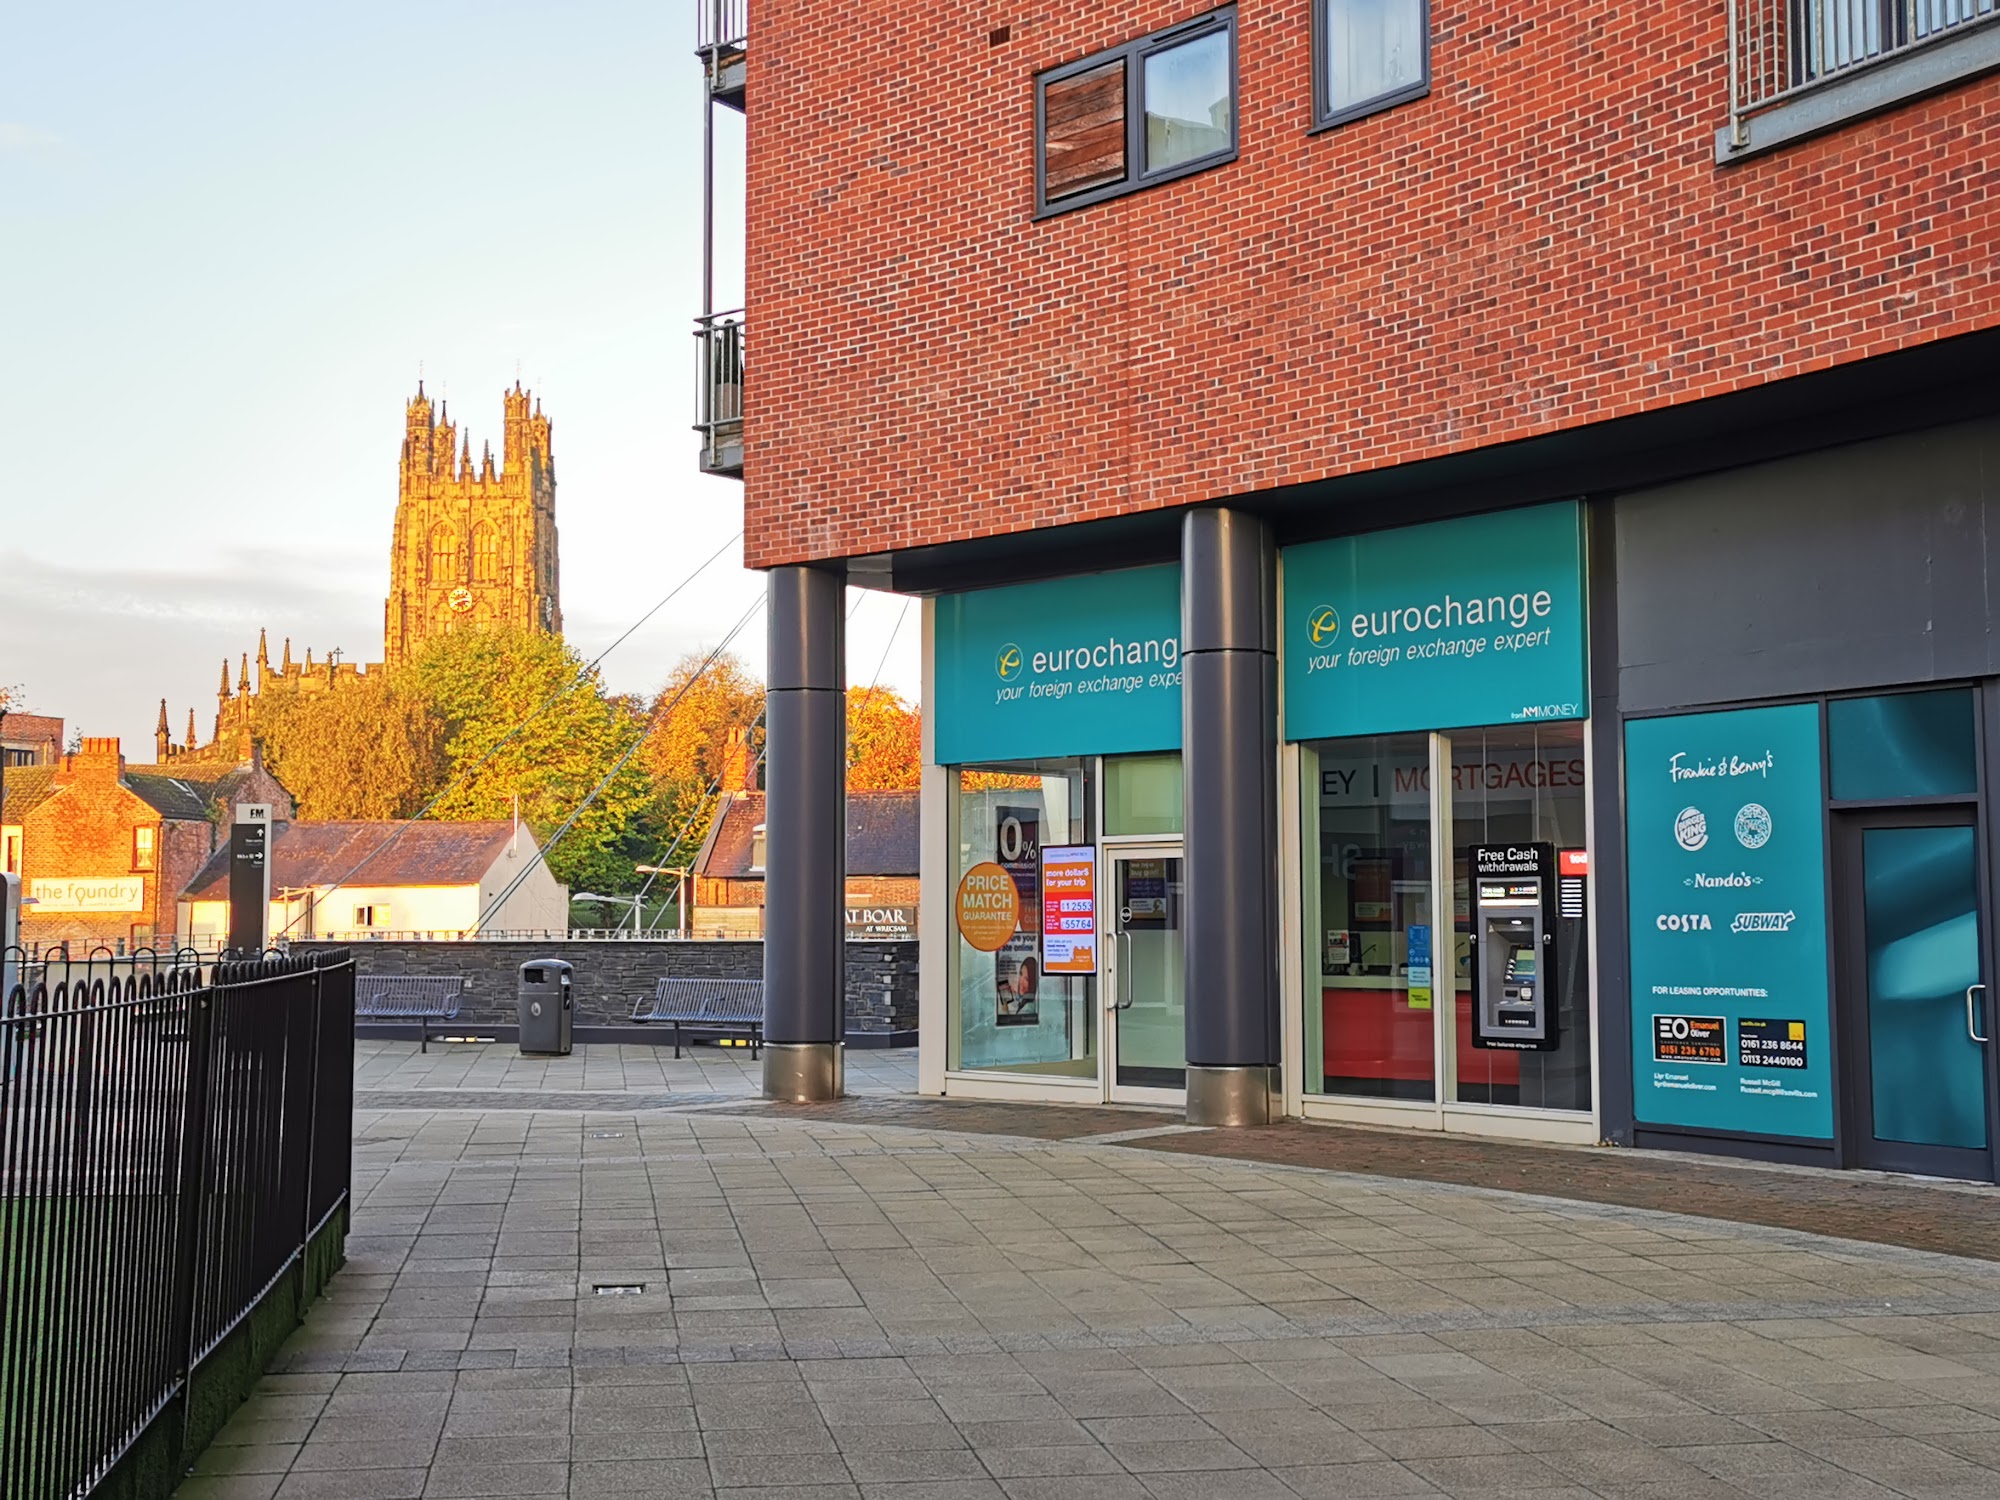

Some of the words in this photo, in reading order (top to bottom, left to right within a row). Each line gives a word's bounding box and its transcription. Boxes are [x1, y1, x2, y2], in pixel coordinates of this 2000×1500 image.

[1351, 590, 1551, 638] eurochange
[1032, 637, 1177, 674] eurochang
[1307, 653, 1341, 674] your
[1348, 644, 1400, 667] foreign
[1406, 635, 1487, 659] exchange
[1493, 627, 1551, 652] expert
[995, 686, 1024, 705] your
[1029, 679, 1073, 699] foreign
[1077, 674, 1143, 694] exchange
[1148, 671, 1182, 690] expe
[1669, 752, 1716, 783] Frankie
[1730, 750, 1773, 778] Benny's
[1680, 821, 1707, 842] KING
[1478, 849, 1504, 861] Free
[1507, 848, 1538, 860] Cash
[1478, 861, 1538, 872] withdrawals
[967, 875, 1009, 891] PRICE
[1057, 879, 1072, 888] your
[1073, 877, 1086, 887] trip
[1694, 871, 1751, 888] Nando's
[35, 883, 63, 899] the
[67, 883, 138, 906] foundry
[963, 894, 1012, 909] MATCH
[863, 908, 907, 923] BOAR
[963, 912, 1012, 921] GUARANTEE
[1731, 912, 1793, 931] SUBWAY
[1656, 914, 1712, 933] COSTA
[1652, 986, 1668, 994] FOR
[1669, 986, 1702, 995] LEASING
[1703, 987, 1768, 997] OPPORTUNITIES:
[1690, 1029, 1710, 1038] Oliver
[1660, 1045, 1678, 1054] 0151
[1681, 1046, 1697, 1055] 236
[1741, 1039, 1760, 1049] 0161
[1762, 1040, 1779, 1050] 236
[1741, 1054, 1760, 1064] 0113
[1762, 1056, 1803, 1067] 2440100
